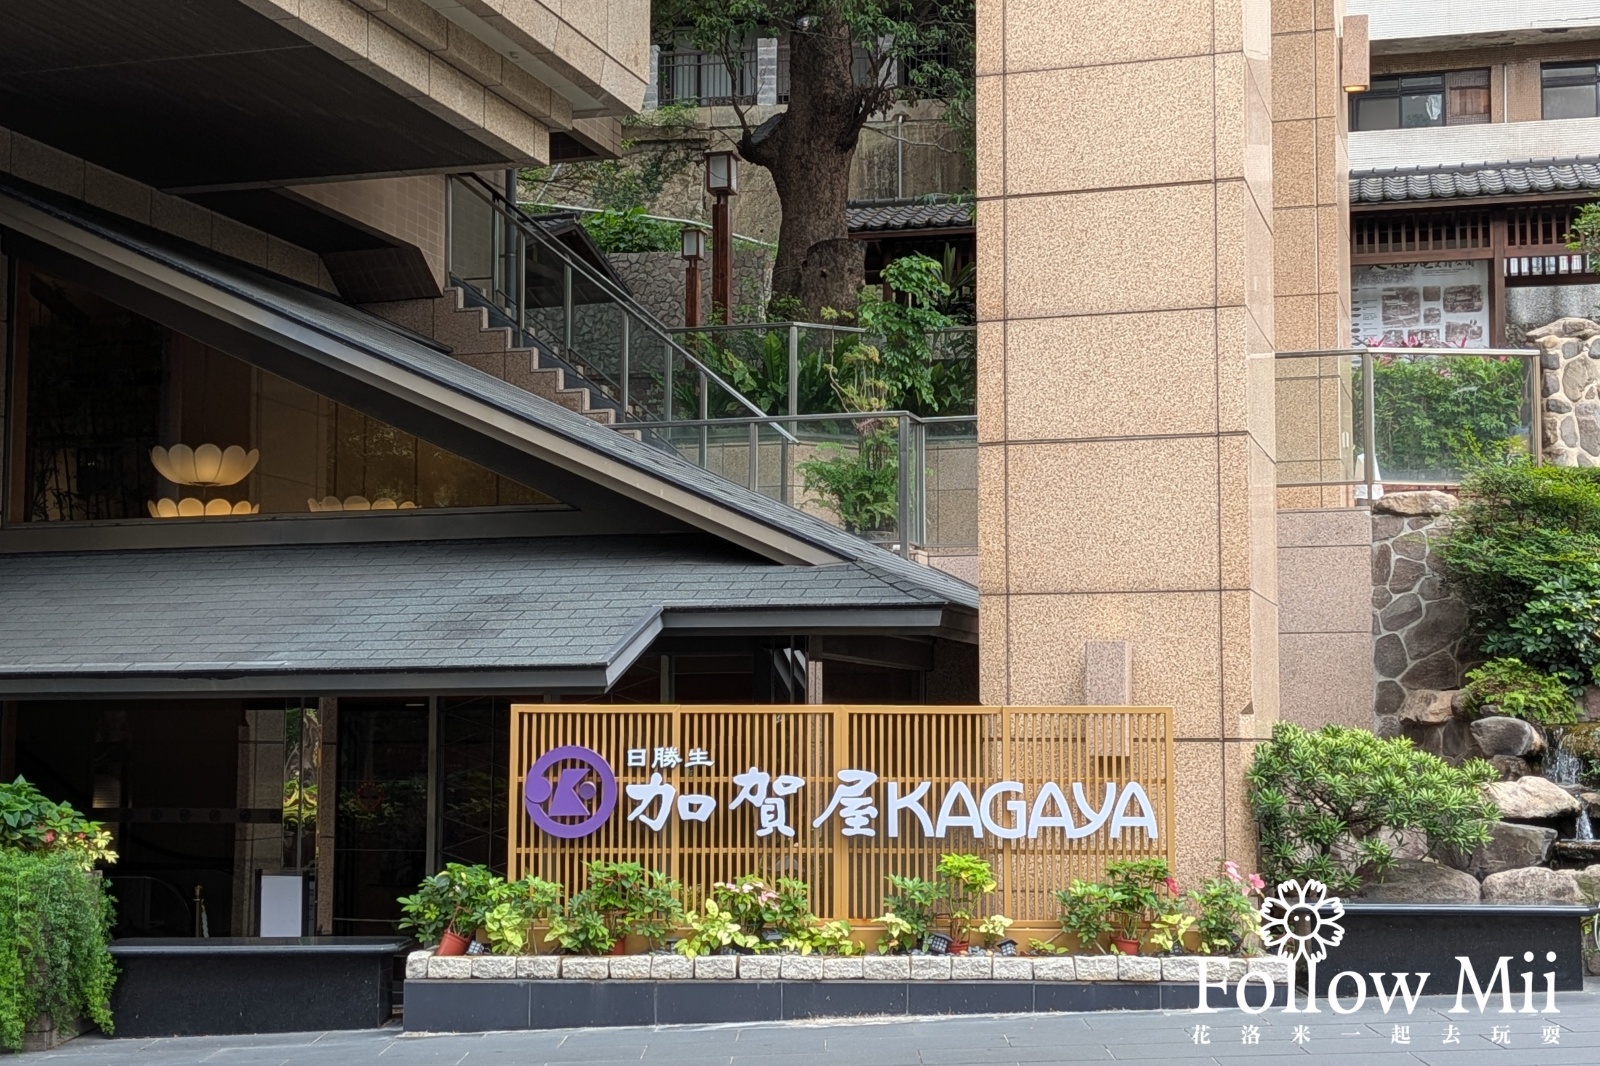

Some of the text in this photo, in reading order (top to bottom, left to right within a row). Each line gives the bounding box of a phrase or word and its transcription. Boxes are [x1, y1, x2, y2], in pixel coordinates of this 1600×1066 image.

[627, 747, 716, 769] 日勝生
[625, 766, 1159, 839] 加賀屋 KAGAYA
